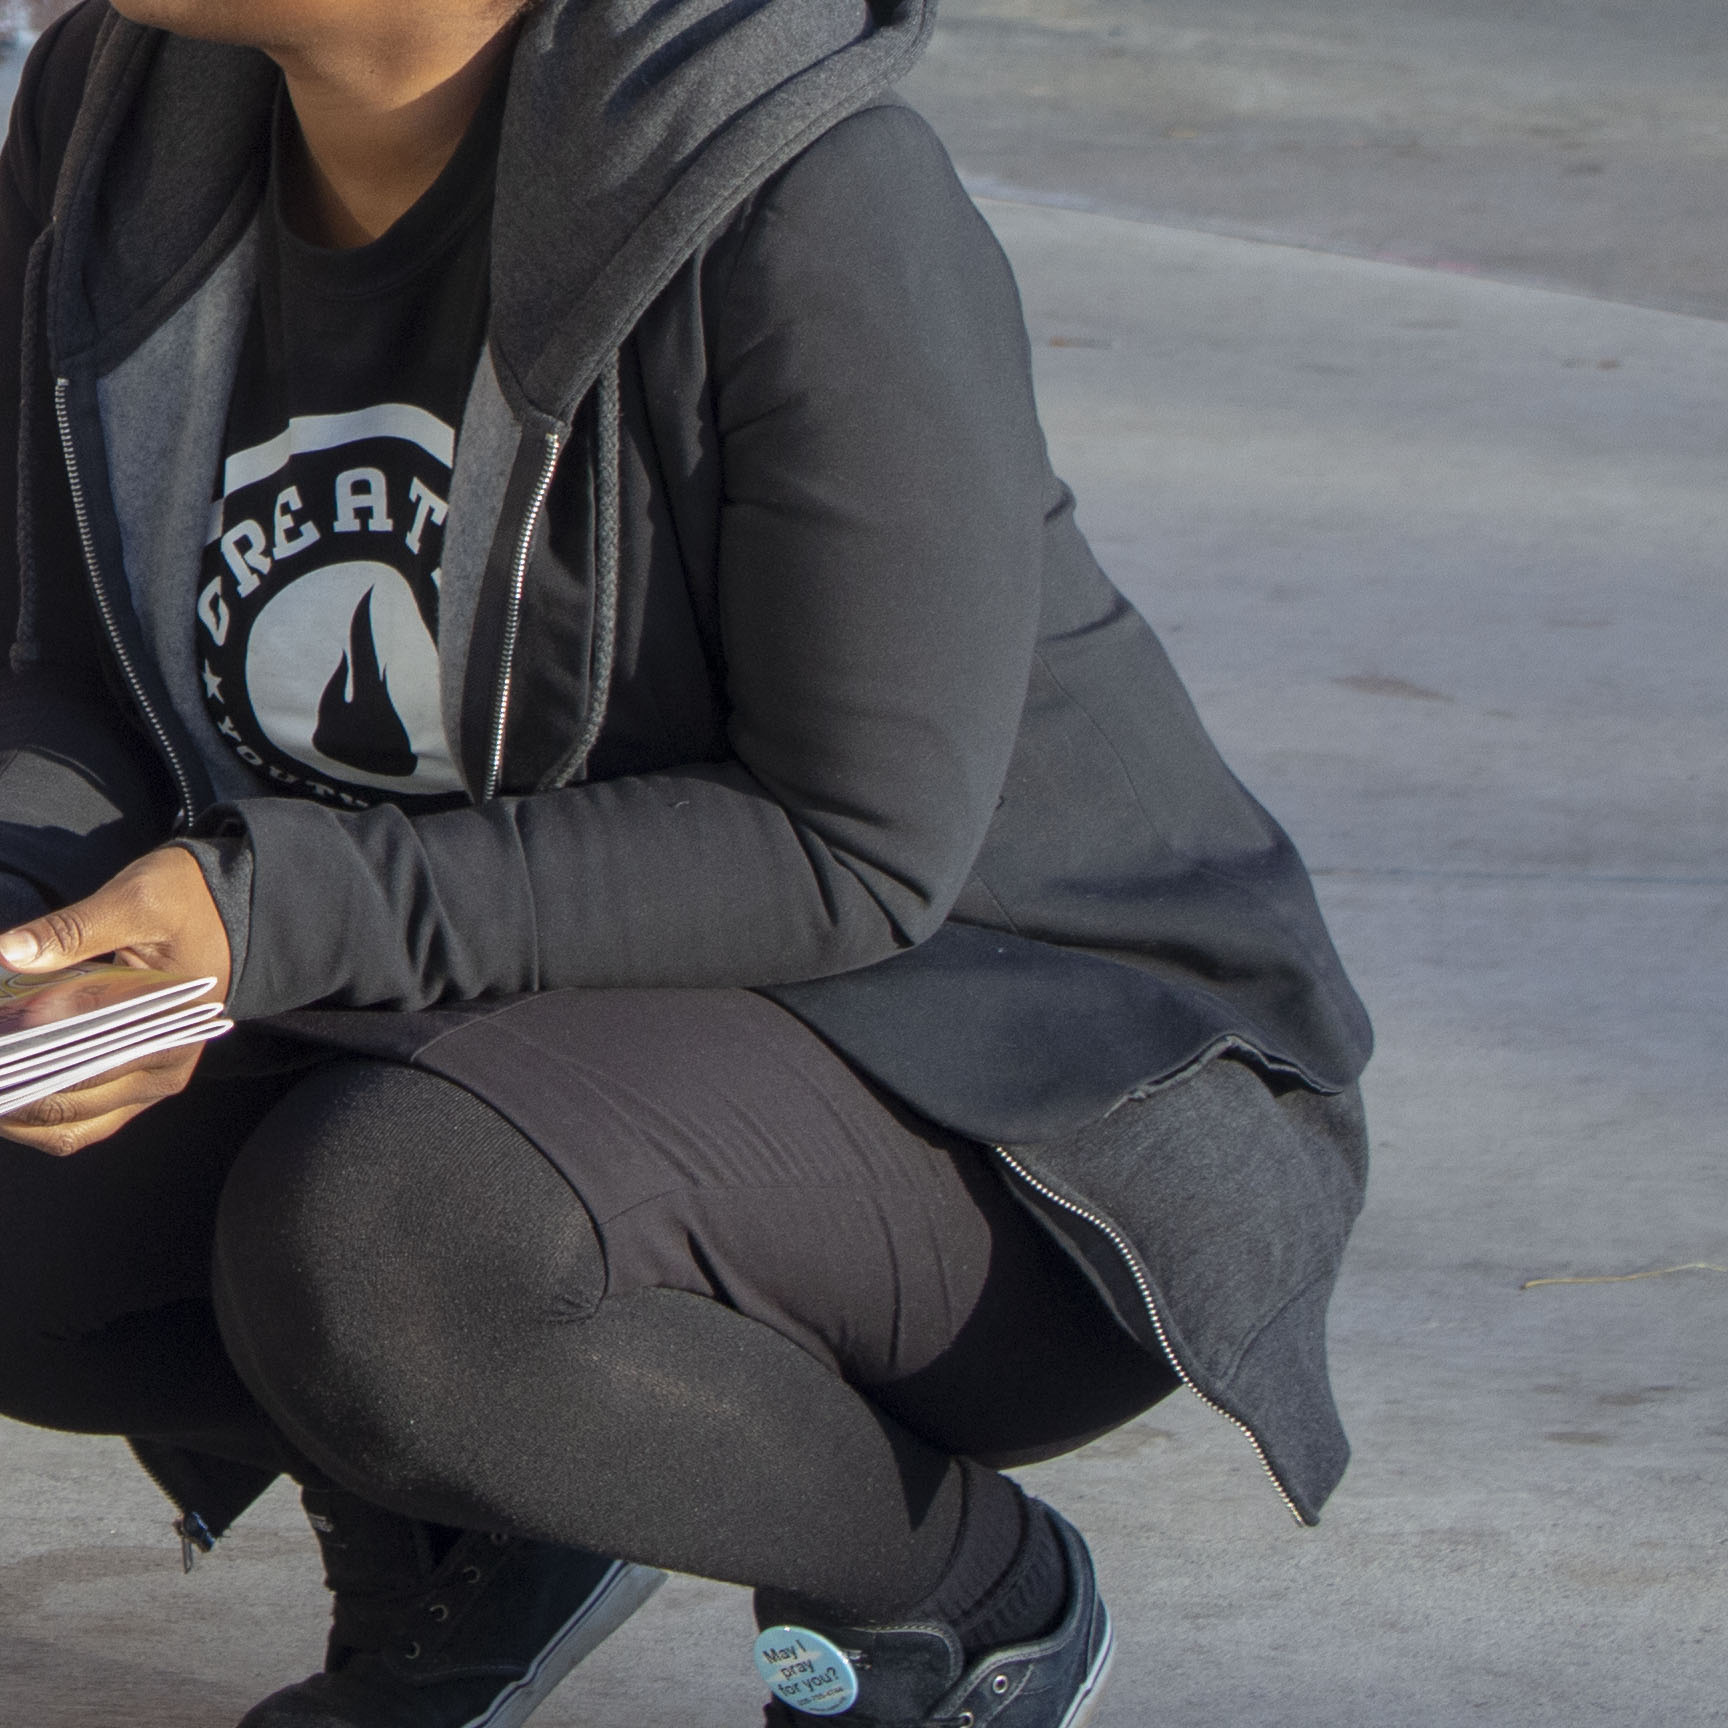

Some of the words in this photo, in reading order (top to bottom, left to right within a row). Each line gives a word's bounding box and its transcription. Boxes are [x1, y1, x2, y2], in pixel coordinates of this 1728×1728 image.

[762, 1645, 798, 1664] May
[795, 1639, 807, 1653] I
[777, 1681, 802, 1697] for
[803, 1666, 840, 1692] you?
[780, 1659, 814, 1680] pray
